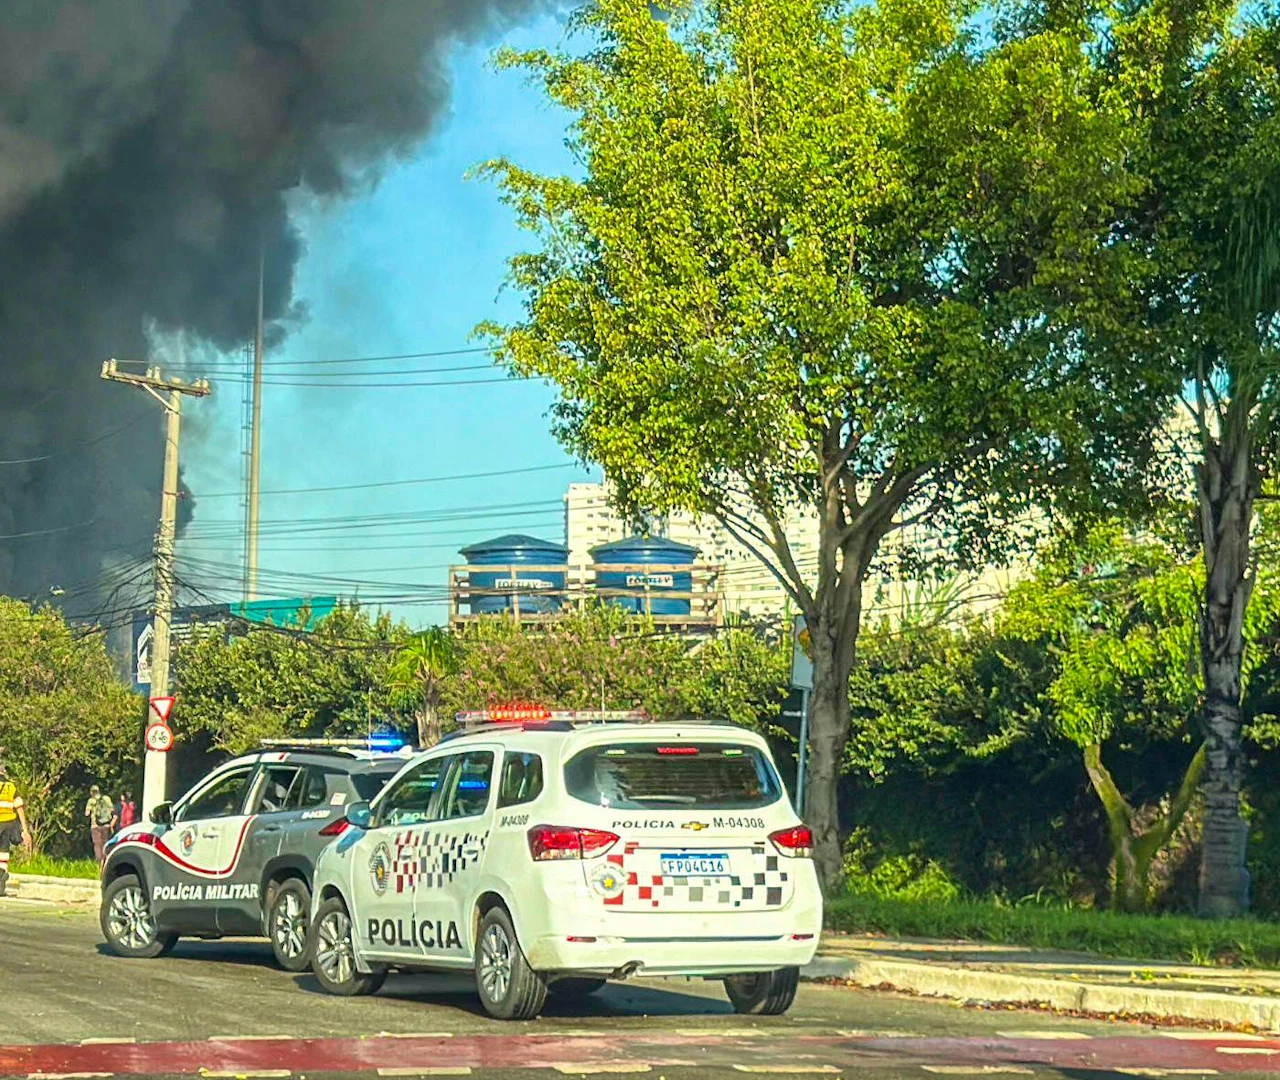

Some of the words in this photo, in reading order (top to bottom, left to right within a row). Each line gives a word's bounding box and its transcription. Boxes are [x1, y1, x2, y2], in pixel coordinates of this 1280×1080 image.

[612, 817, 675, 829] POLÍCIA
[153, 882, 202, 900] POLÍCIA
[205, 882, 259, 900] MILITAR
[367, 912, 463, 949] POLÍCIA
